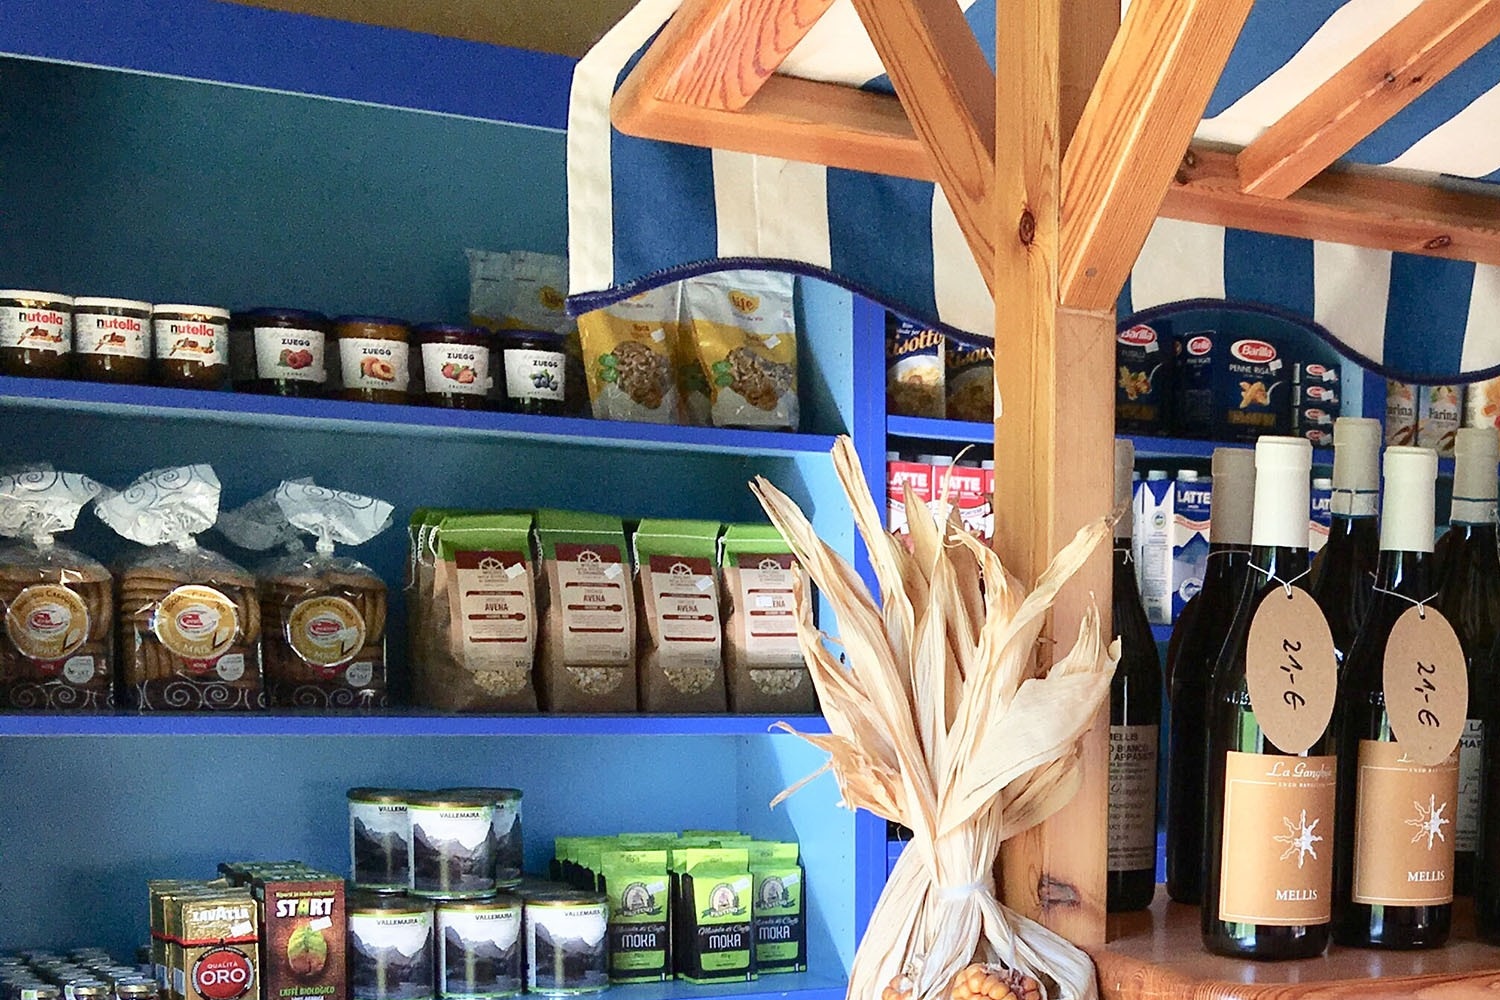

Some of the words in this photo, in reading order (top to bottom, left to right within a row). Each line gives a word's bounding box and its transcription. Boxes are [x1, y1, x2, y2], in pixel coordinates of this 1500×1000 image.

[18, 310, 63, 326] nutella
[96, 317, 141, 331] nutella
[170, 323, 215, 337] nutella
[1120, 328, 1154, 341] Barilla
[281, 338, 310, 347] ZUEGG
[893, 330, 945, 355] isotto
[362, 347, 392, 356] ZUEGG
[447, 352, 475, 360] ZUEGG
[1241, 345, 1274, 357] Barilla
[533, 359, 558, 368] ZUEGG
[1229, 364, 1251, 372] PENNE
[1387, 403, 1413, 417] arina
[1429, 408, 1458, 421] Farina
[891, 471, 928, 487] ATTE
[1176, 490, 1211, 504] LATTE
[1312, 498, 1331, 510] LAT
[485, 603, 508, 611] AVENA
[1280, 639, 1303, 685] 21,-
[1283, 690, 1306, 711] €
[1266, 761, 1290, 777] La
[1408, 871, 1445, 882] MELLIS
[1276, 890, 1318, 900] MELLIS
[276, 898, 335, 918] START
[759, 925, 791, 941] MOKA
[622, 934, 657, 949] MOKA
[708, 934, 742, 949] MOKA
[200, 967, 246, 986] ORO
